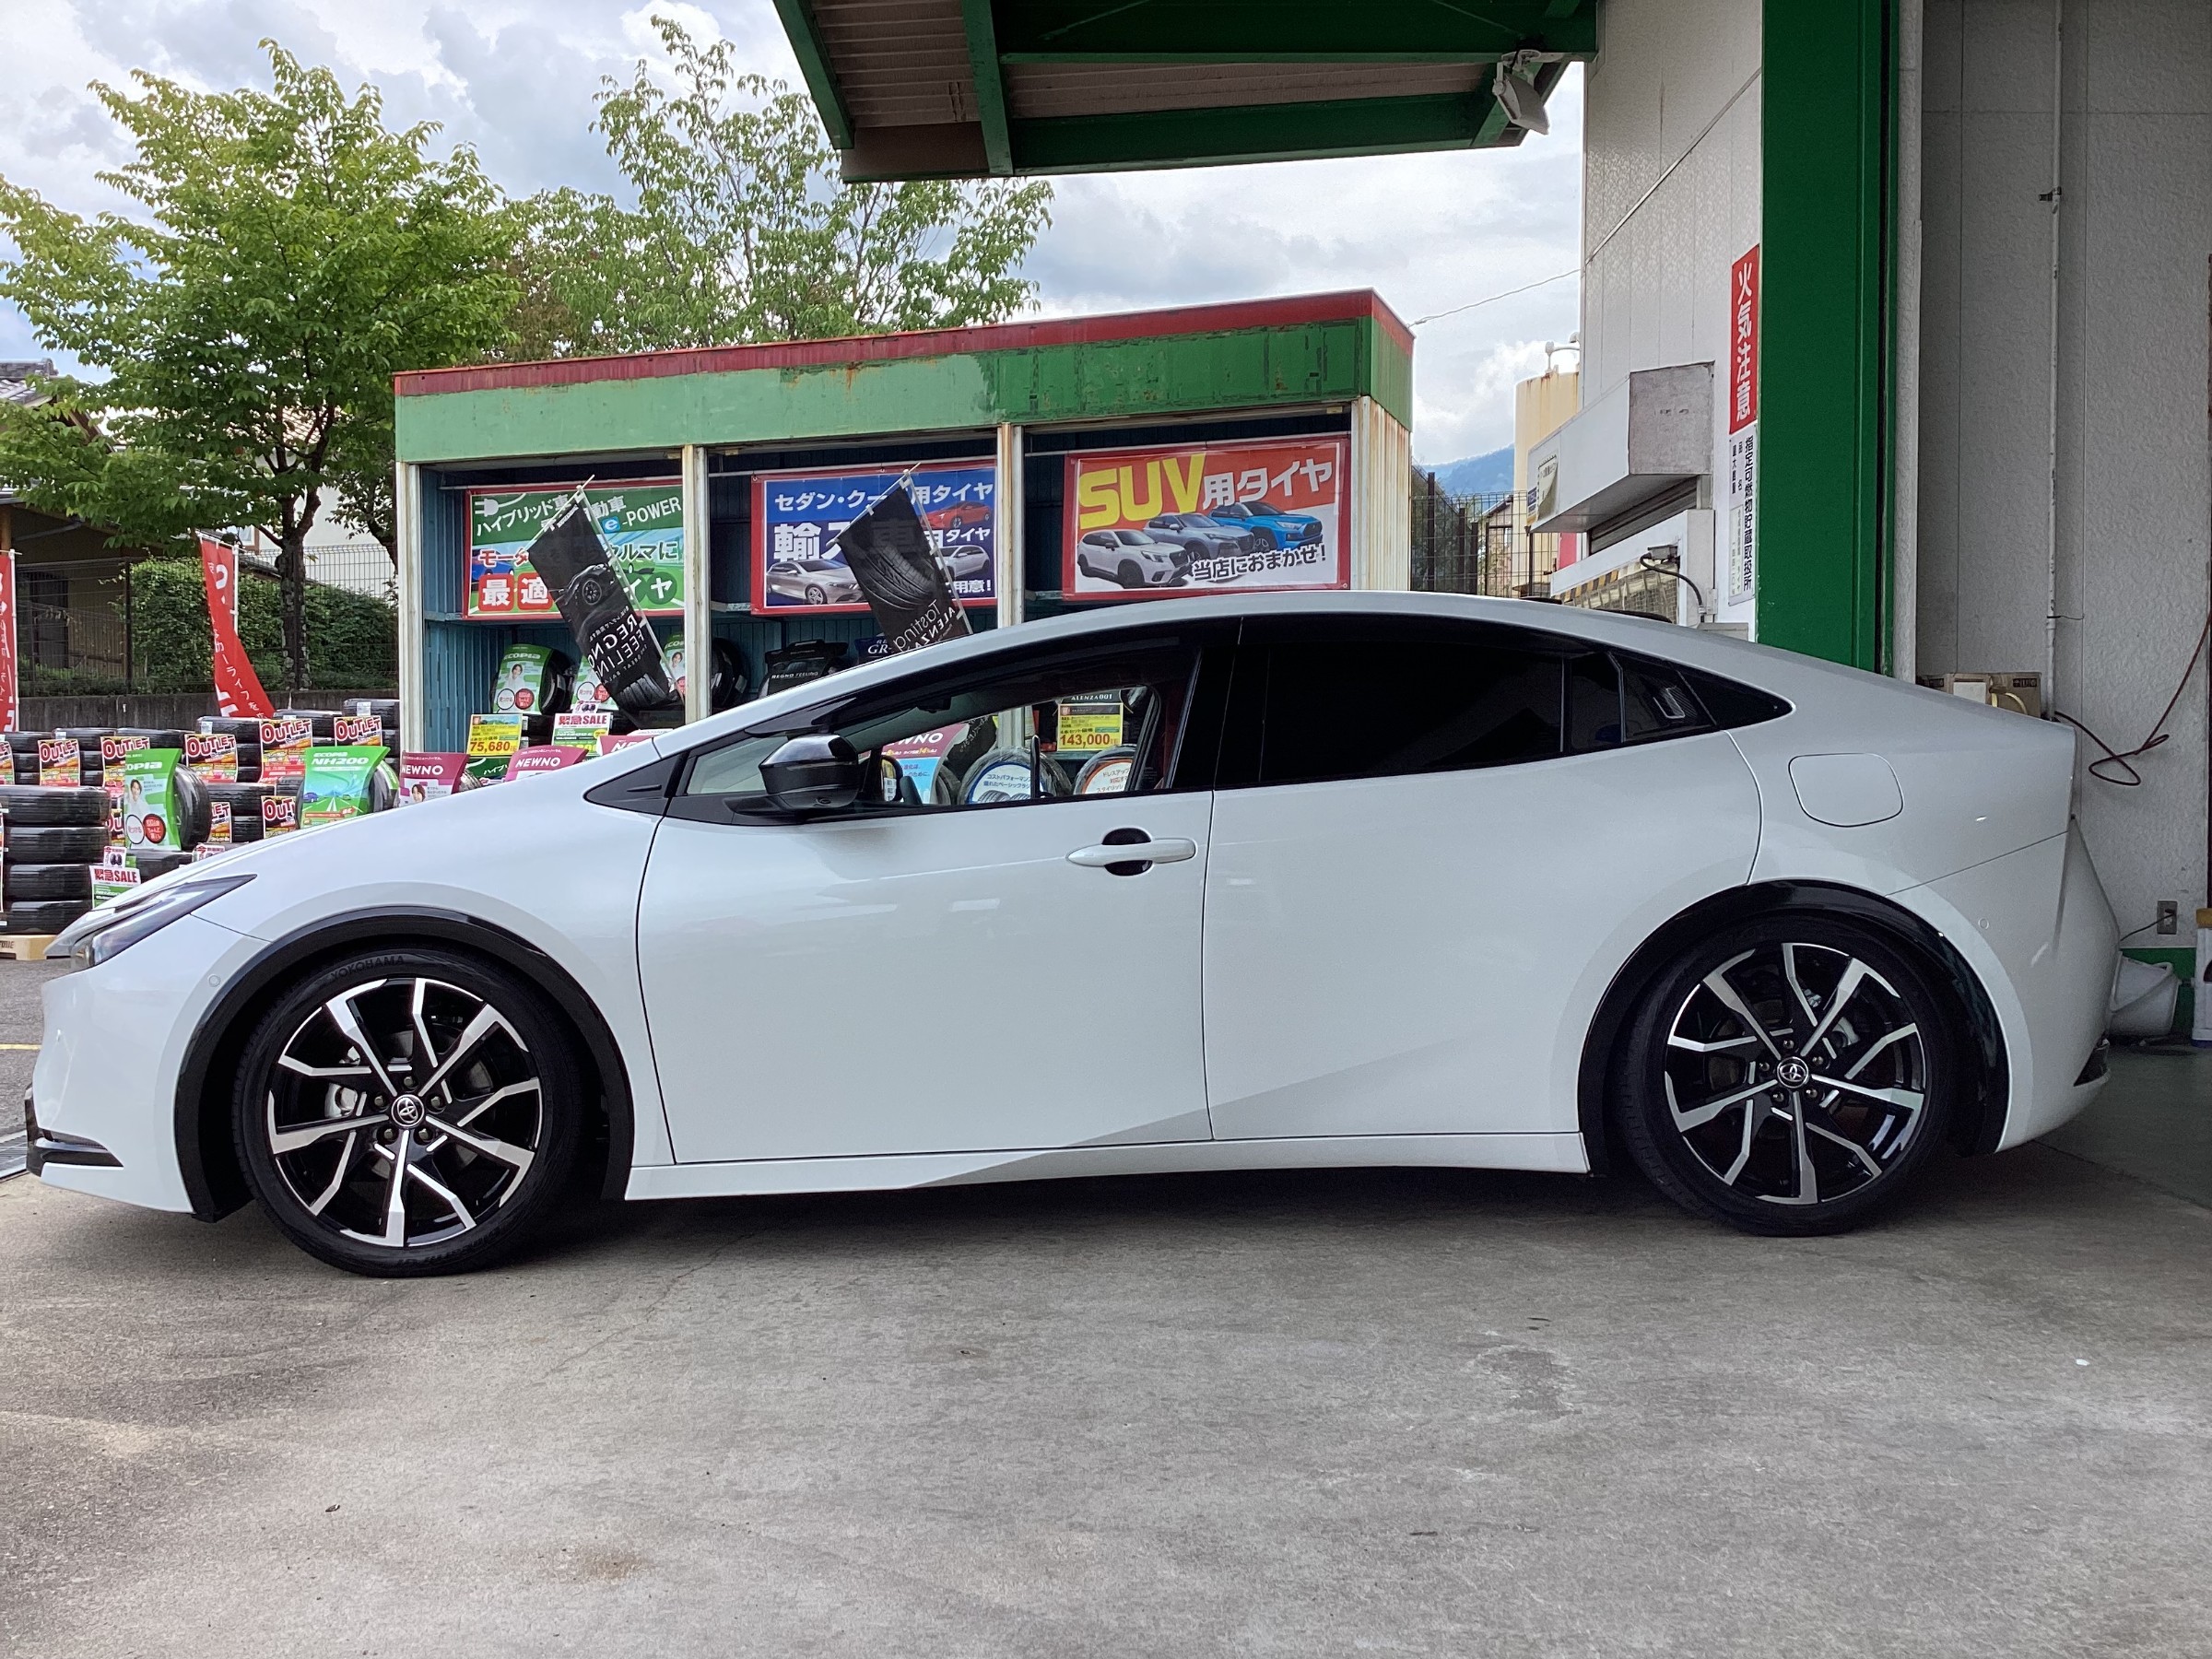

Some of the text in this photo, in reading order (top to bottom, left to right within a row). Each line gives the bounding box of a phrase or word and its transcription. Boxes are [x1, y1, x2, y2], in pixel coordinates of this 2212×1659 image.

[1737, 262, 1752, 422] 火気注意
[775, 482, 994, 512] セダン・クー用タイヤ
[1079, 452, 1334, 529] SUV用タイヤ
[477, 494, 571, 536] ハイブリッド車
[1194, 544, 1326, 581] 当店におまかせ!
[261, 719, 311, 743] OUTLET
[335, 717, 381, 740] OUTLET
[888, 732, 943, 746] WNO
[40, 741, 77, 762] OUTLET
[186, 736, 236, 756] OUTLET
[470, 741, 511, 753] 75,680
[1061, 734, 1110, 748] 143,000
[125, 761, 163, 771] OPIA
[401, 764, 444, 775] NEWNO
[514, 757, 561, 768] NEWNO
[330, 956, 405, 979] YOKOHAMA
